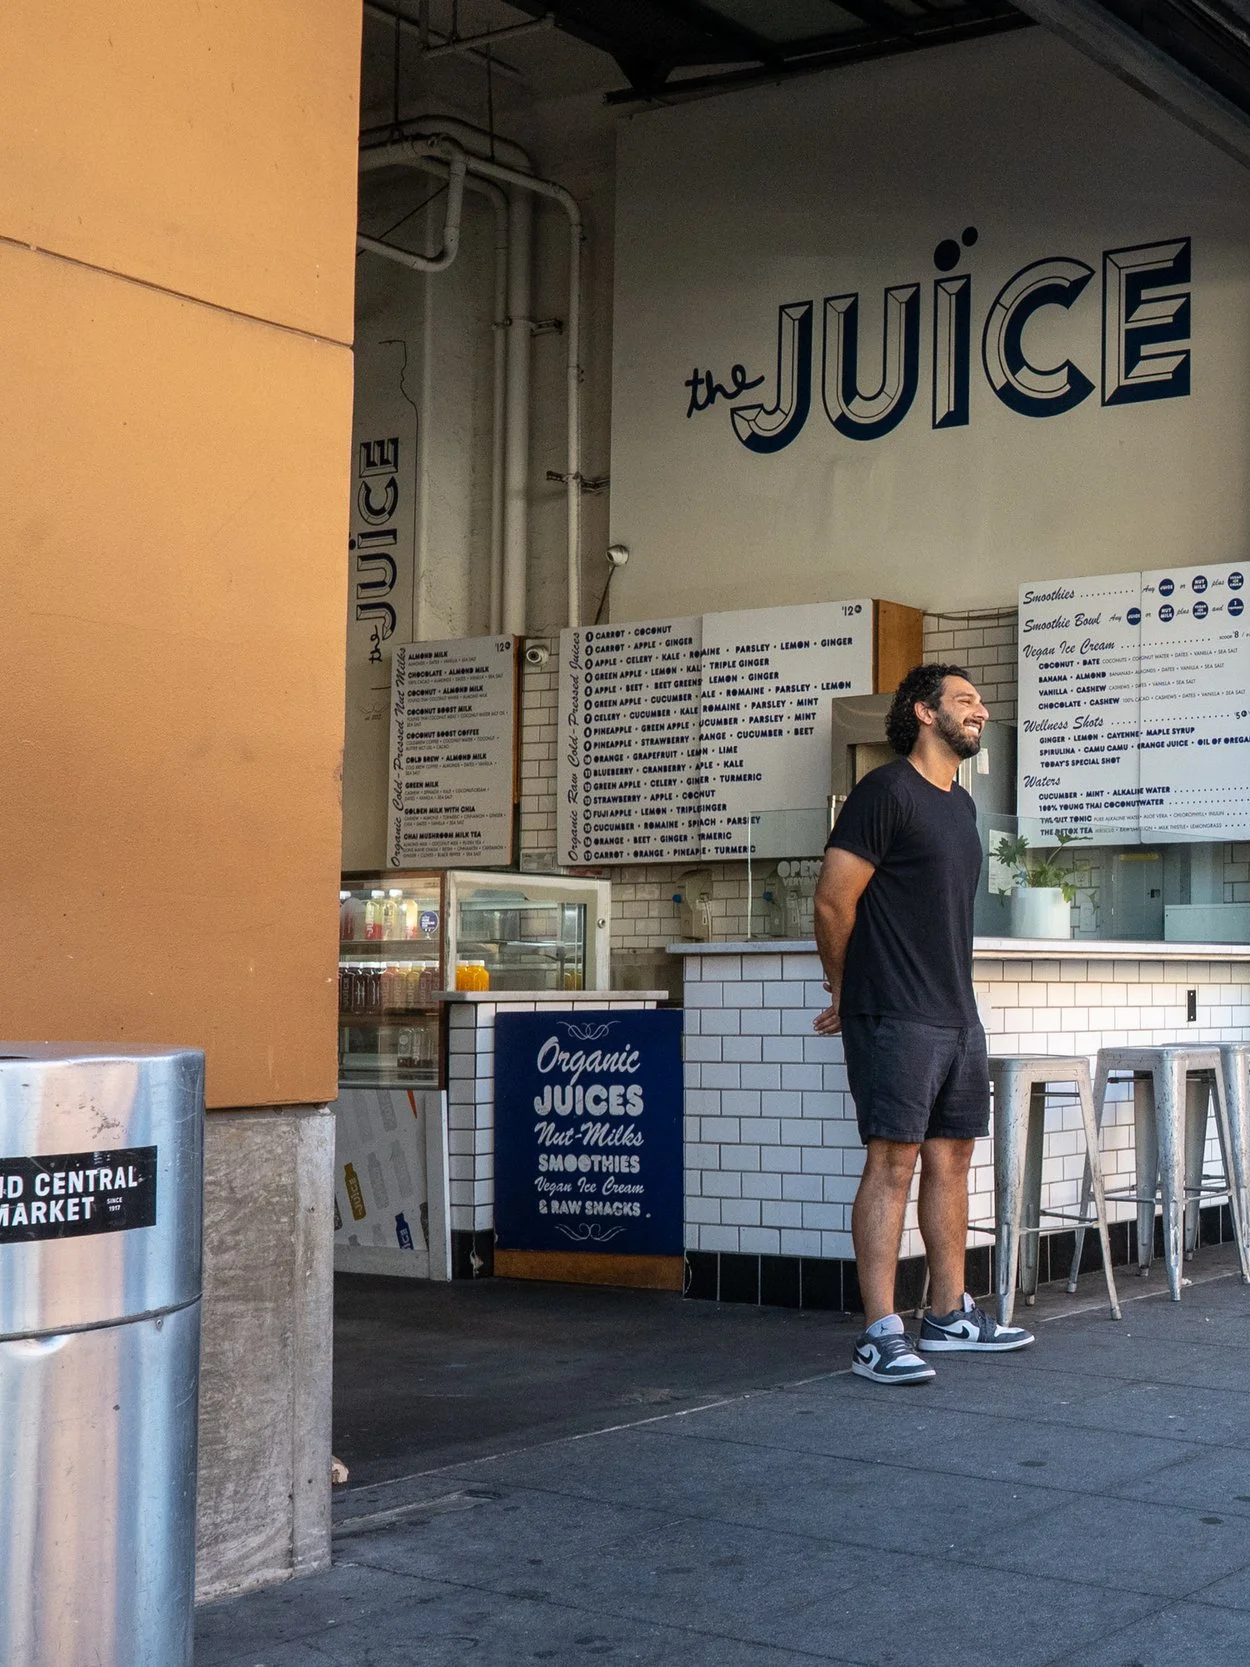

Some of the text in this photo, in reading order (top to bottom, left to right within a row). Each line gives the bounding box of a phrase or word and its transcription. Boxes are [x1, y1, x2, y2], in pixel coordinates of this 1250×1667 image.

[685, 226, 1192, 454] the JUICE
[354, 437, 400, 641] JUICE
[1023, 586, 1075, 605] Smoothies
[1023, 612, 1102, 633] Smoothie Bowl
[595, 625, 672, 640] CARROT COCONUT
[595, 637, 693, 654] CARROT APPLE GINGER
[595, 637, 853, 667] APPLE CELERY KALE PARSLEY LEMON GINGER
[1023, 638, 1115, 660] Vegan Ice Cream
[594, 658, 770, 681] GREEN APPLE LEMON TRIPLE GINGER
[1038, 658, 1100, 670] COCONUT DATE
[594, 685, 616, 695] APPLE
[625, 683, 643, 692] BEET
[654, 680, 672, 689] BEET
[709, 674, 738, 684] LEMON
[748, 671, 779, 681] GINGER
[1075, 671, 1107, 680] ALMOND
[594, 680, 852, 708] GREEN APPLE CUCUMBER ROMAINE PARSLEY LEMON
[1038, 685, 1107, 696] VANILLA CASHEW
[594, 697, 819, 722] CELERY CUCUMBER KALE ROMAINE PARSLEY MINT
[1038, 697, 1120, 710] CHOCOLATE CASHEW
[593, 712, 817, 736] PINEAPPLE GREEN APPLE PARSLEY MINT
[1023, 714, 1104, 733] Wellness Shots
[736, 727, 814, 739] CUCUMBER BEET
[1039, 727, 1195, 744] GINGER LEMON CAYENNE MAPLE SYRUP
[567, 632, 583, 861] Organic Raw Cold-Pressed Juices
[633, 750, 678, 761] GRAPEFRUIT
[1039, 748, 1076, 756] SPIRULINA
[1083, 745, 1105, 753] CAMU
[1106, 744, 1128, 752] CAMU
[1197, 738, 1210, 746] OIL
[642, 763, 686, 774] CRANBERRY
[1071, 758, 1100, 766] SPECIAL
[720, 773, 762, 783] TURMERIC
[1023, 775, 1061, 788] Waters
[1038, 786, 1170, 800] CUCUMBER MINT WATER
[1060, 803, 1084, 811] YOUNG
[1070, 815, 1092, 823] TONIC
[594, 851, 624, 859] CARROT
[536, 1036, 641, 1086] Organic
[534, 1084, 644, 1116] JUICES
[534, 1121, 644, 1148] Nut-Milks
[538, 1153, 641, 1174] SMOOTHIES
[35, 1165, 139, 1197] CENTRAL
[534, 1176, 645, 1197] Vegan Ice Cream
[106, 1197, 123, 1205] SINCE
[551, 1200, 582, 1215] RAW
[585, 1201, 641, 1217] SNACKS
